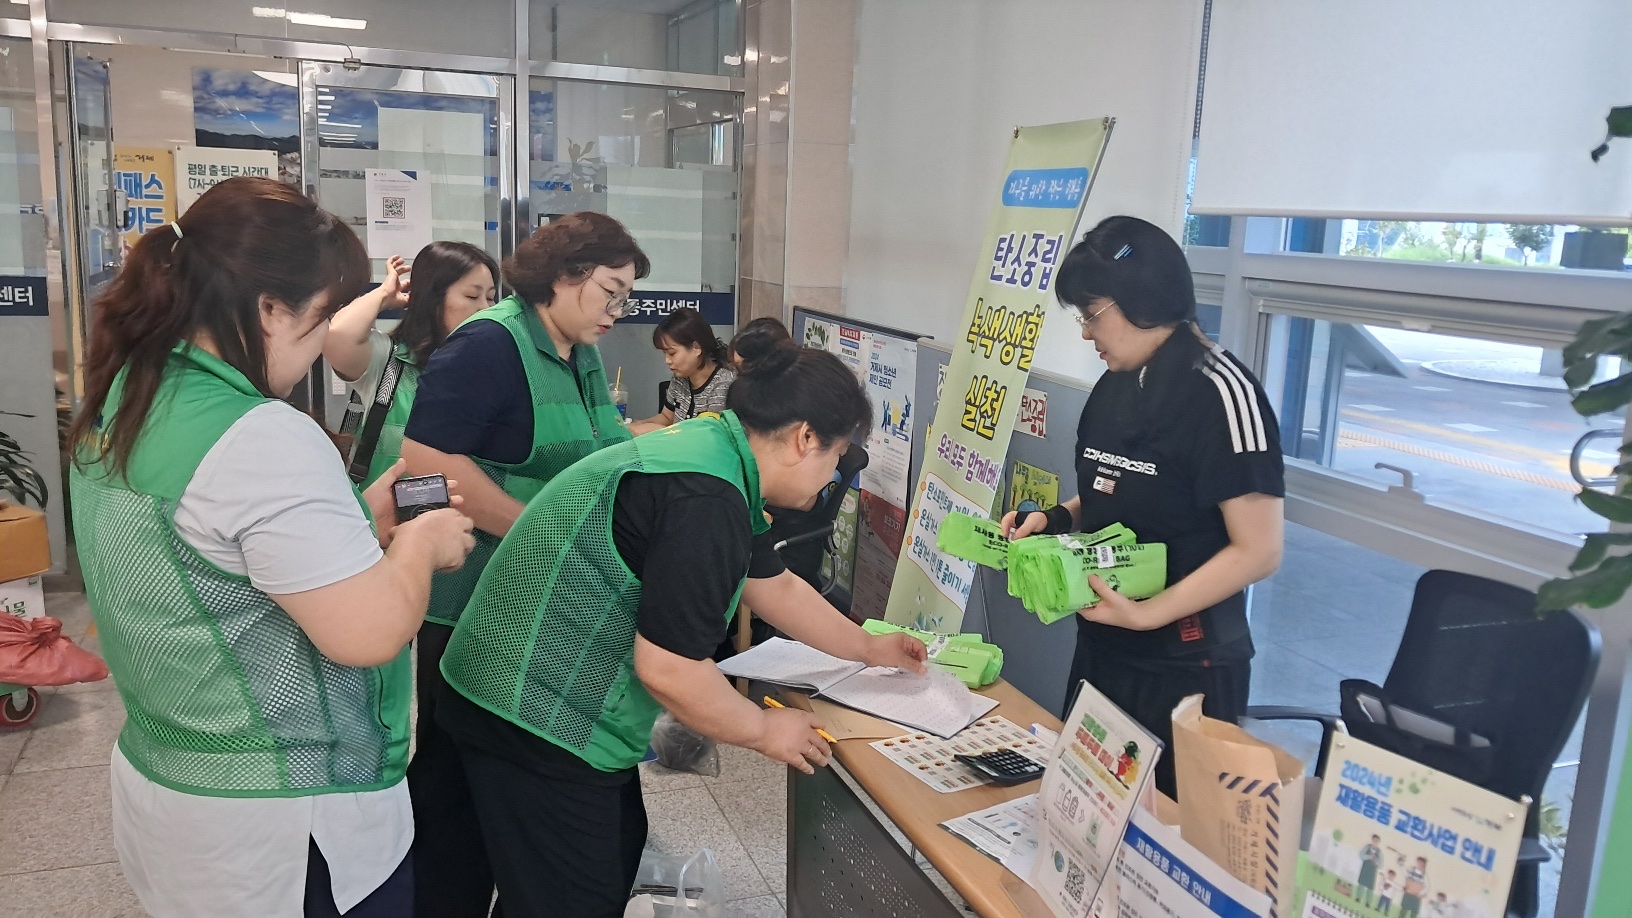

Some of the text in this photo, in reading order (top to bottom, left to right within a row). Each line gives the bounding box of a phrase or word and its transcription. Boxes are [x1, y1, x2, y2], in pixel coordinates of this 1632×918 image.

[187, 163, 206, 176] 평일
[989, 231, 1065, 292] 탄소중립
[0, 285, 33, 306] 센터
[967, 297, 1045, 373] 녹색생활
[960, 373, 1008, 442] 실천
[1115, 554, 1131, 563] BAG
[1340, 758, 1394, 798] 2024년
[1335, 783, 1393, 826] 재활용품
[1395, 808, 1459, 857] 교환사업
[1459, 836, 1498, 872] 안내
[1136, 837, 1171, 874] 재활용품
[1172, 864, 1191, 890] 교환
[1192, 881, 1213, 907] 안내
